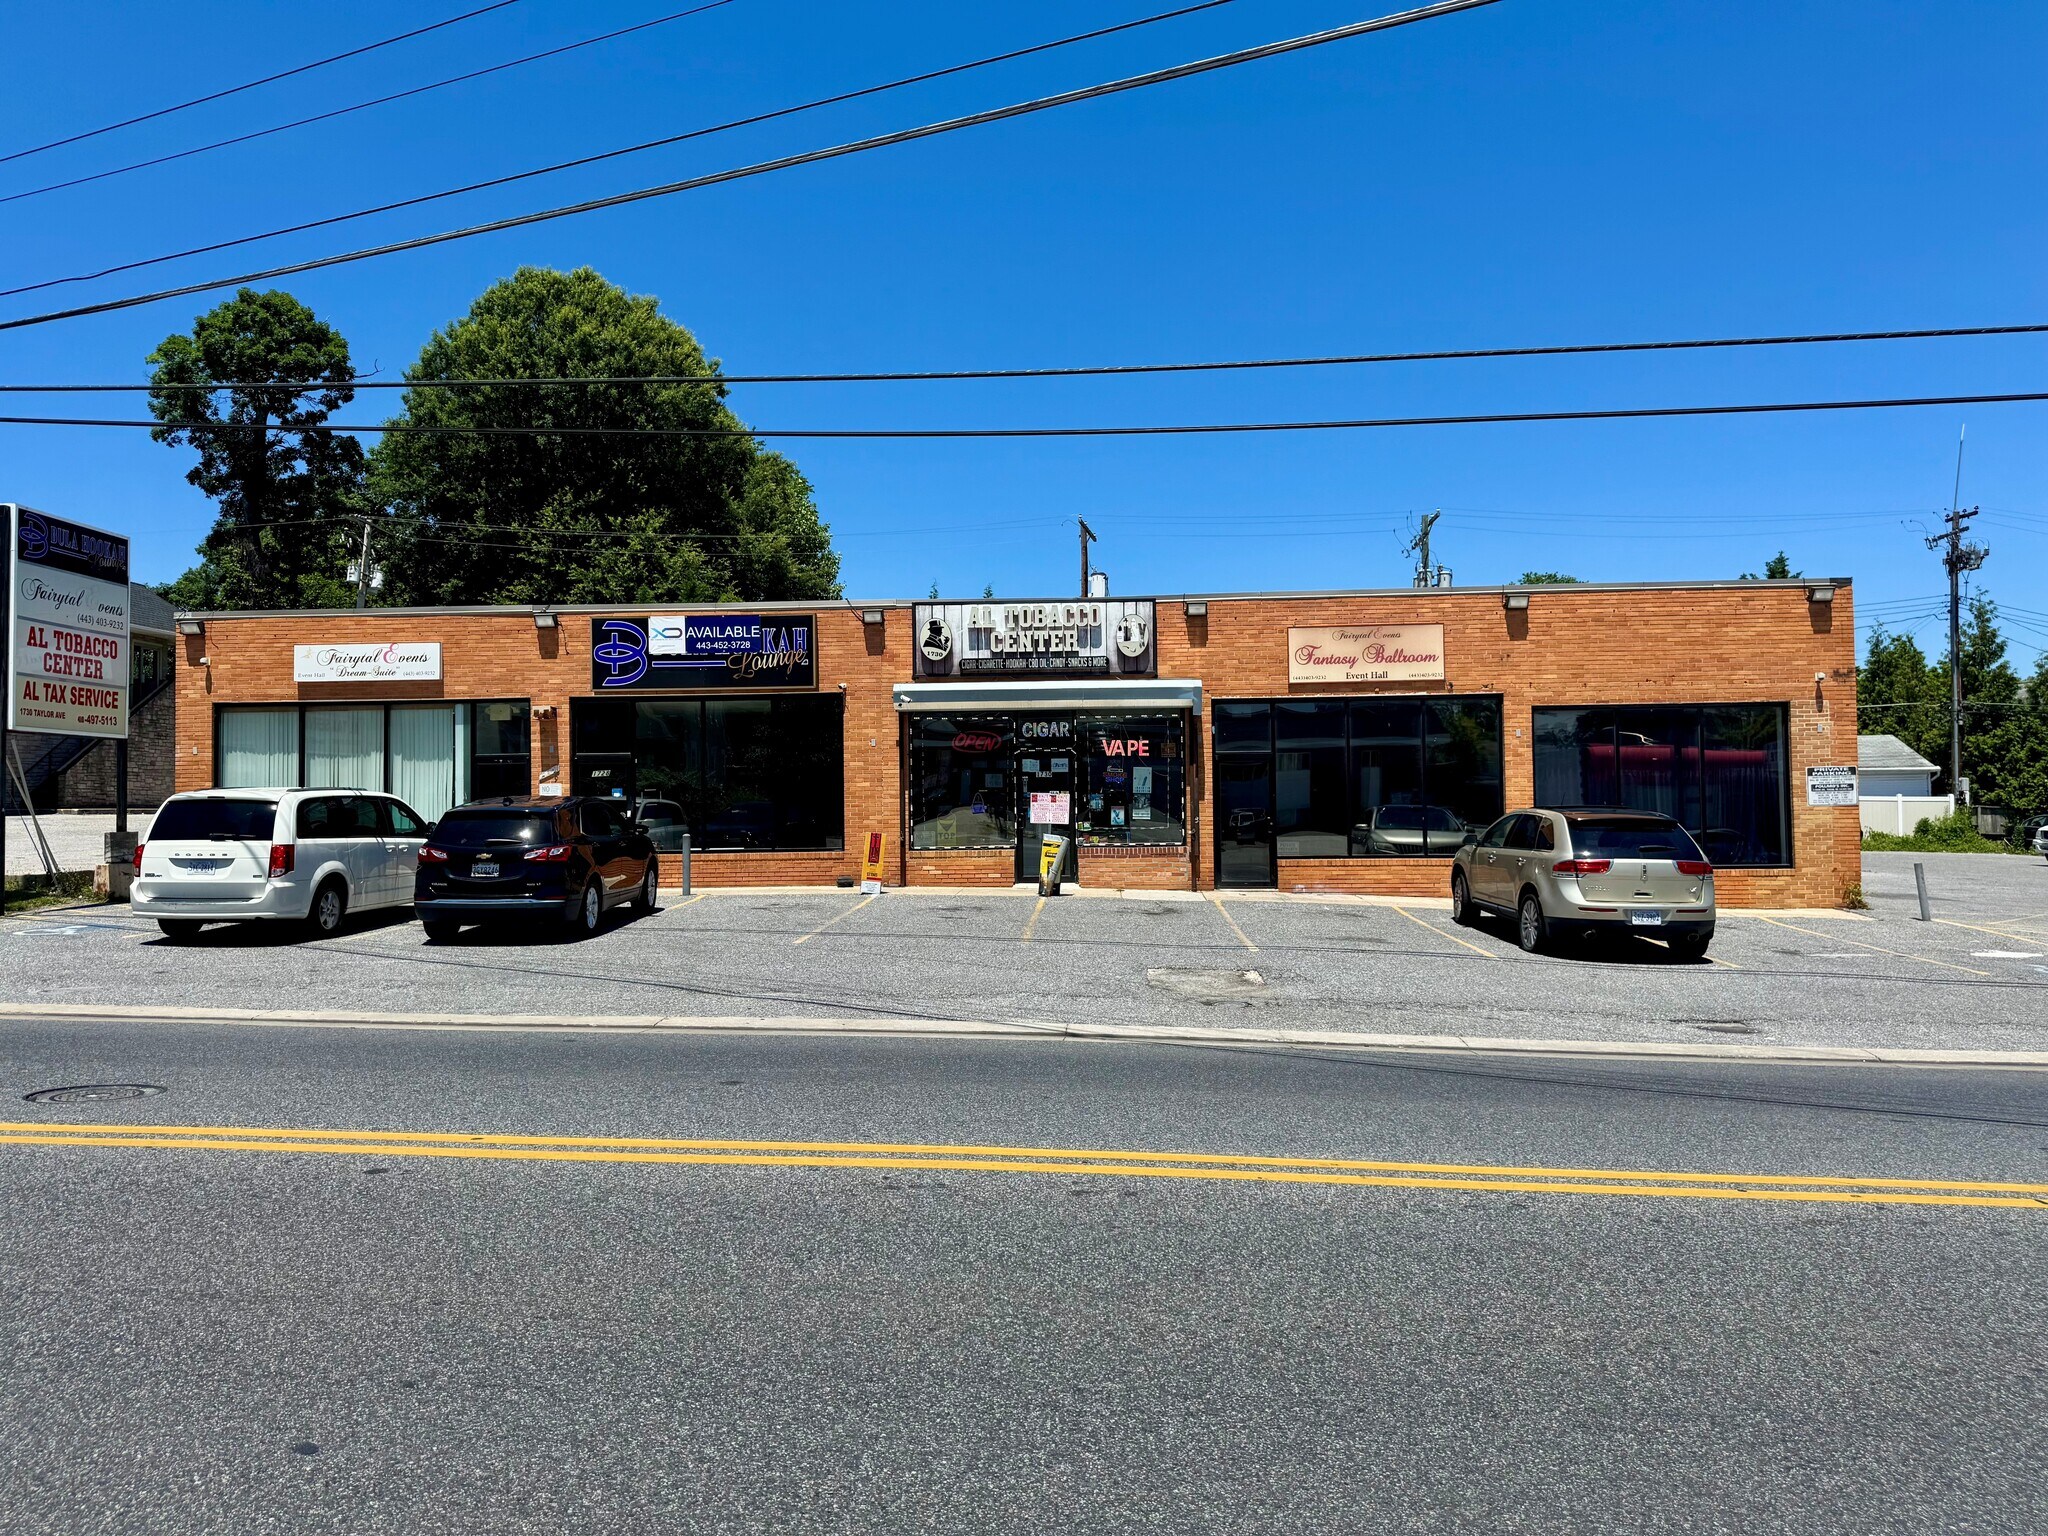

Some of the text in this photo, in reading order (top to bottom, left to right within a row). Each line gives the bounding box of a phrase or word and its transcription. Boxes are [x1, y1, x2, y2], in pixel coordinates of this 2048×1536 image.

[81, 535, 126, 561] HOOKAH
[21, 578, 85, 610] Fairytal
[77, 613, 124, 631] (443) 403-9232
[967, 605, 1101, 629] AL TOBACCO
[686, 626, 760, 638] AVAILABLE
[762, 627, 808, 654] KAH
[990, 631, 1079, 652] CENTER
[1332, 627, 1401, 642] Fairytal Events
[27, 626, 118, 660] AL TOBACCO
[696, 641, 751, 649] 443-452-3728
[317, 642, 430, 668] Fairytal Events
[727, 648, 805, 678] Lounge
[1006, 658, 1026, 668] HOOKAH
[1068, 657, 1087, 667] SNACKS
[1093, 656, 1107, 667] MORE
[1295, 642, 1439, 669] Fantasy Ballroom
[43, 652, 103, 680] CENTER
[1371, 671, 1388, 679] Hall
[23, 680, 119, 709] AL TAX SERVICE
[20, 707, 66, 719] 1730 TAYLOR AVE
[1022, 722, 1070, 737] CIGAR
[955, 733, 996, 750] OPEN
[1102, 739, 1150, 757] VAPE
